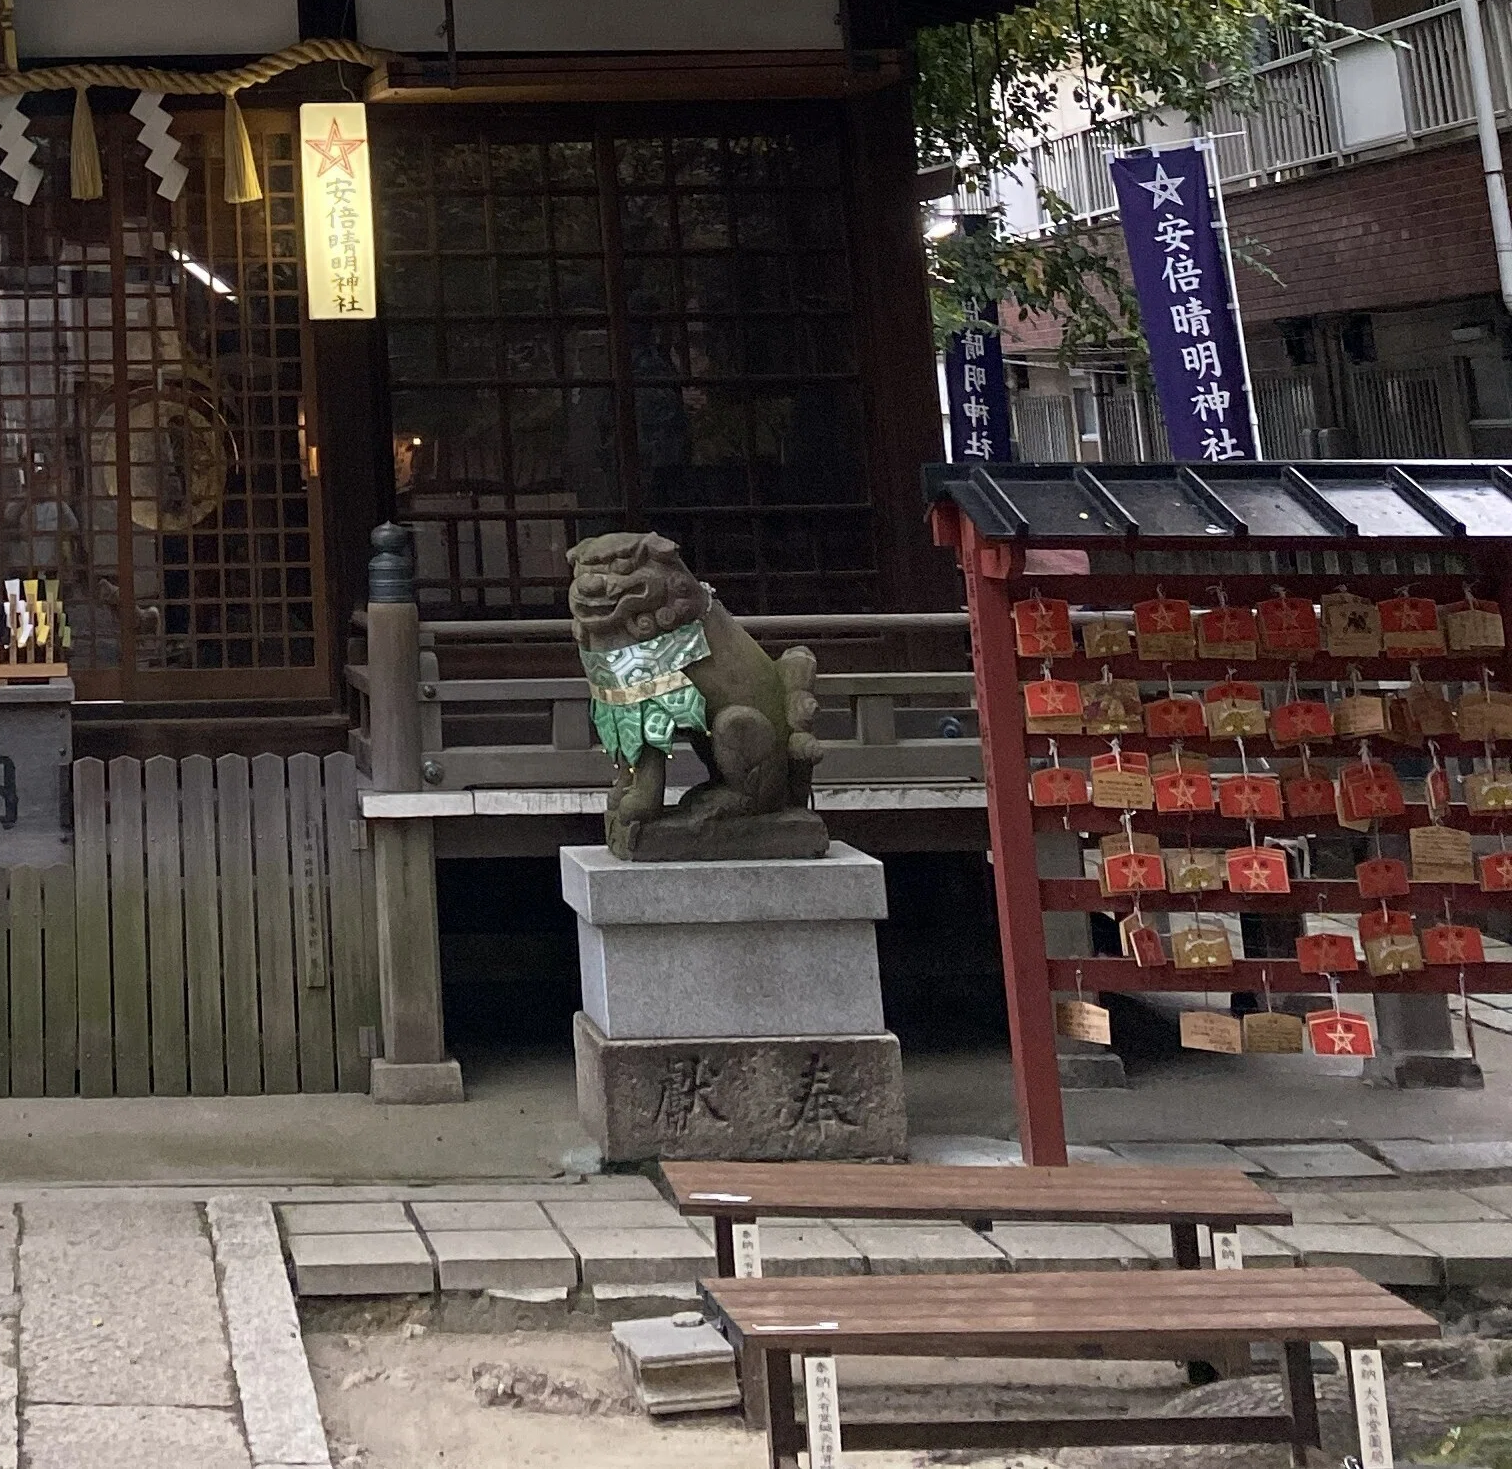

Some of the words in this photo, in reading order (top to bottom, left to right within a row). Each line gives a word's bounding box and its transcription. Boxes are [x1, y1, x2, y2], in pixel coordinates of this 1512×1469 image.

[325, 177, 364, 313] 安倍晴明神社
[1153, 213, 1245, 462] 安倍晴明神社
